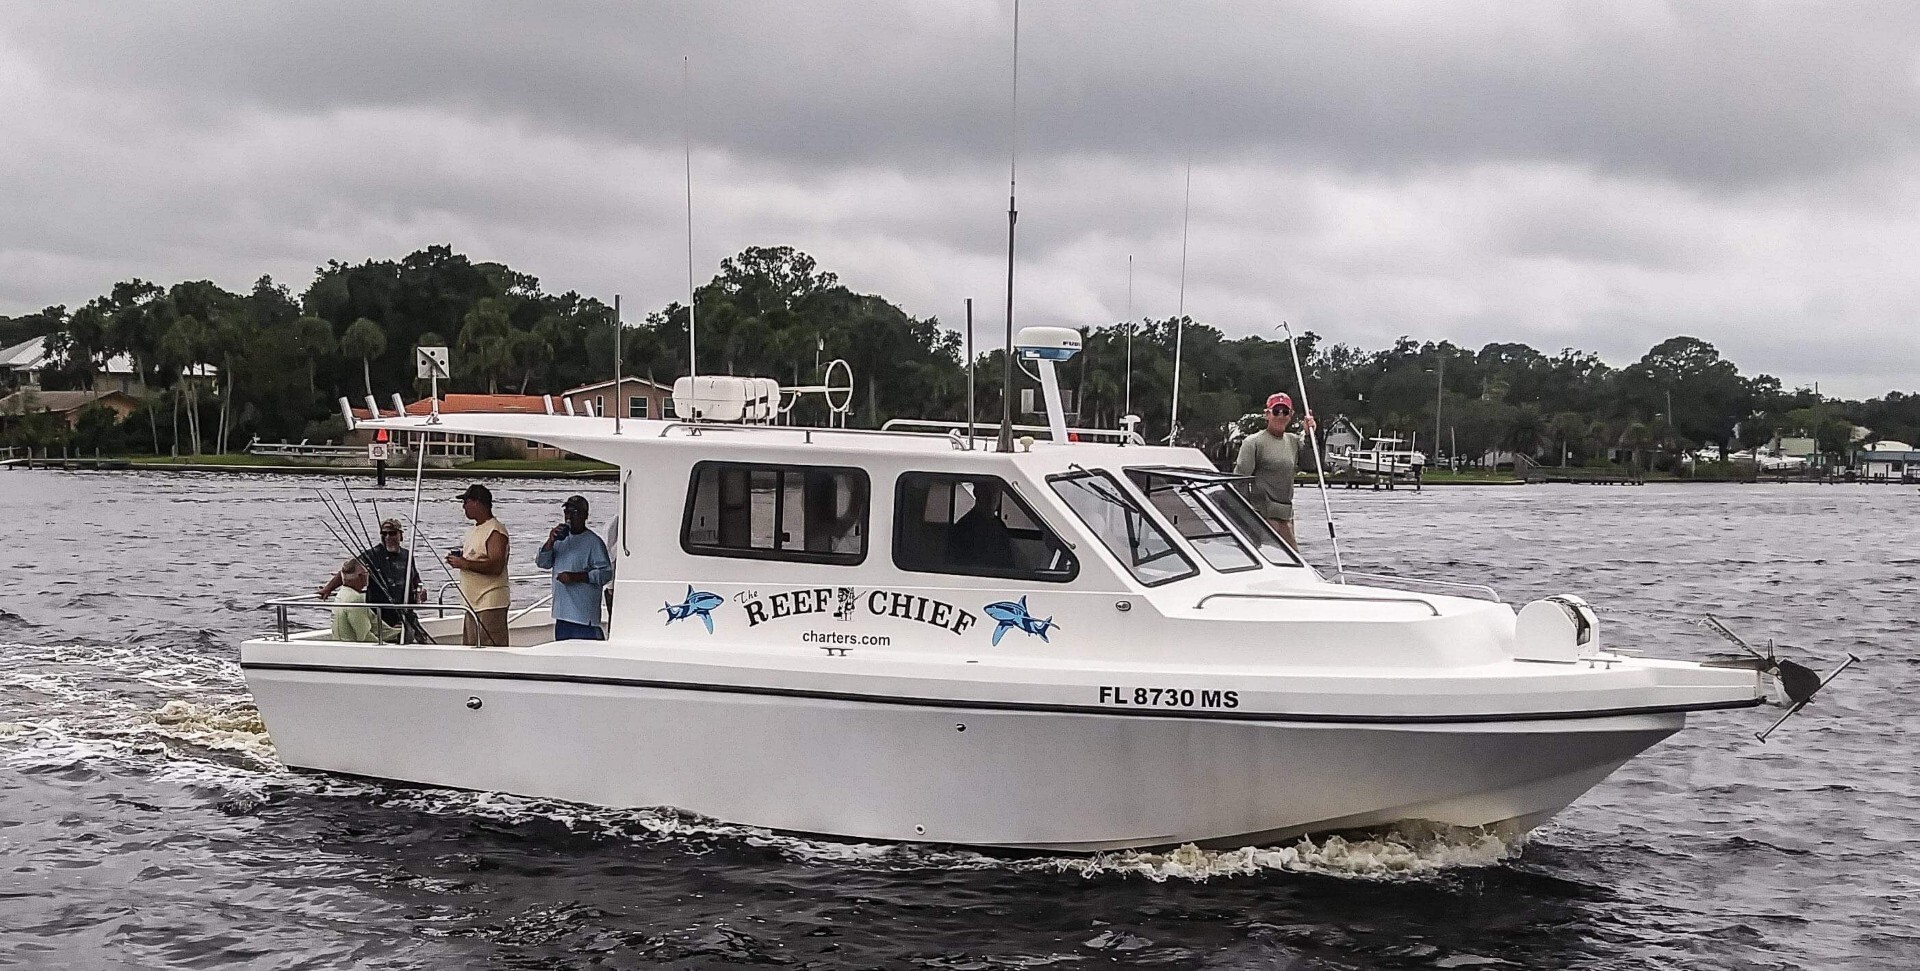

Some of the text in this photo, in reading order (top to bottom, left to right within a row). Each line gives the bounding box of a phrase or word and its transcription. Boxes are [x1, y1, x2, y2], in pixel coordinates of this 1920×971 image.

[733, 588, 977, 635] The REEF CHIEF
[802, 630, 891, 646] charters.com
[1099, 686, 1239, 708] FL 8730 MS
